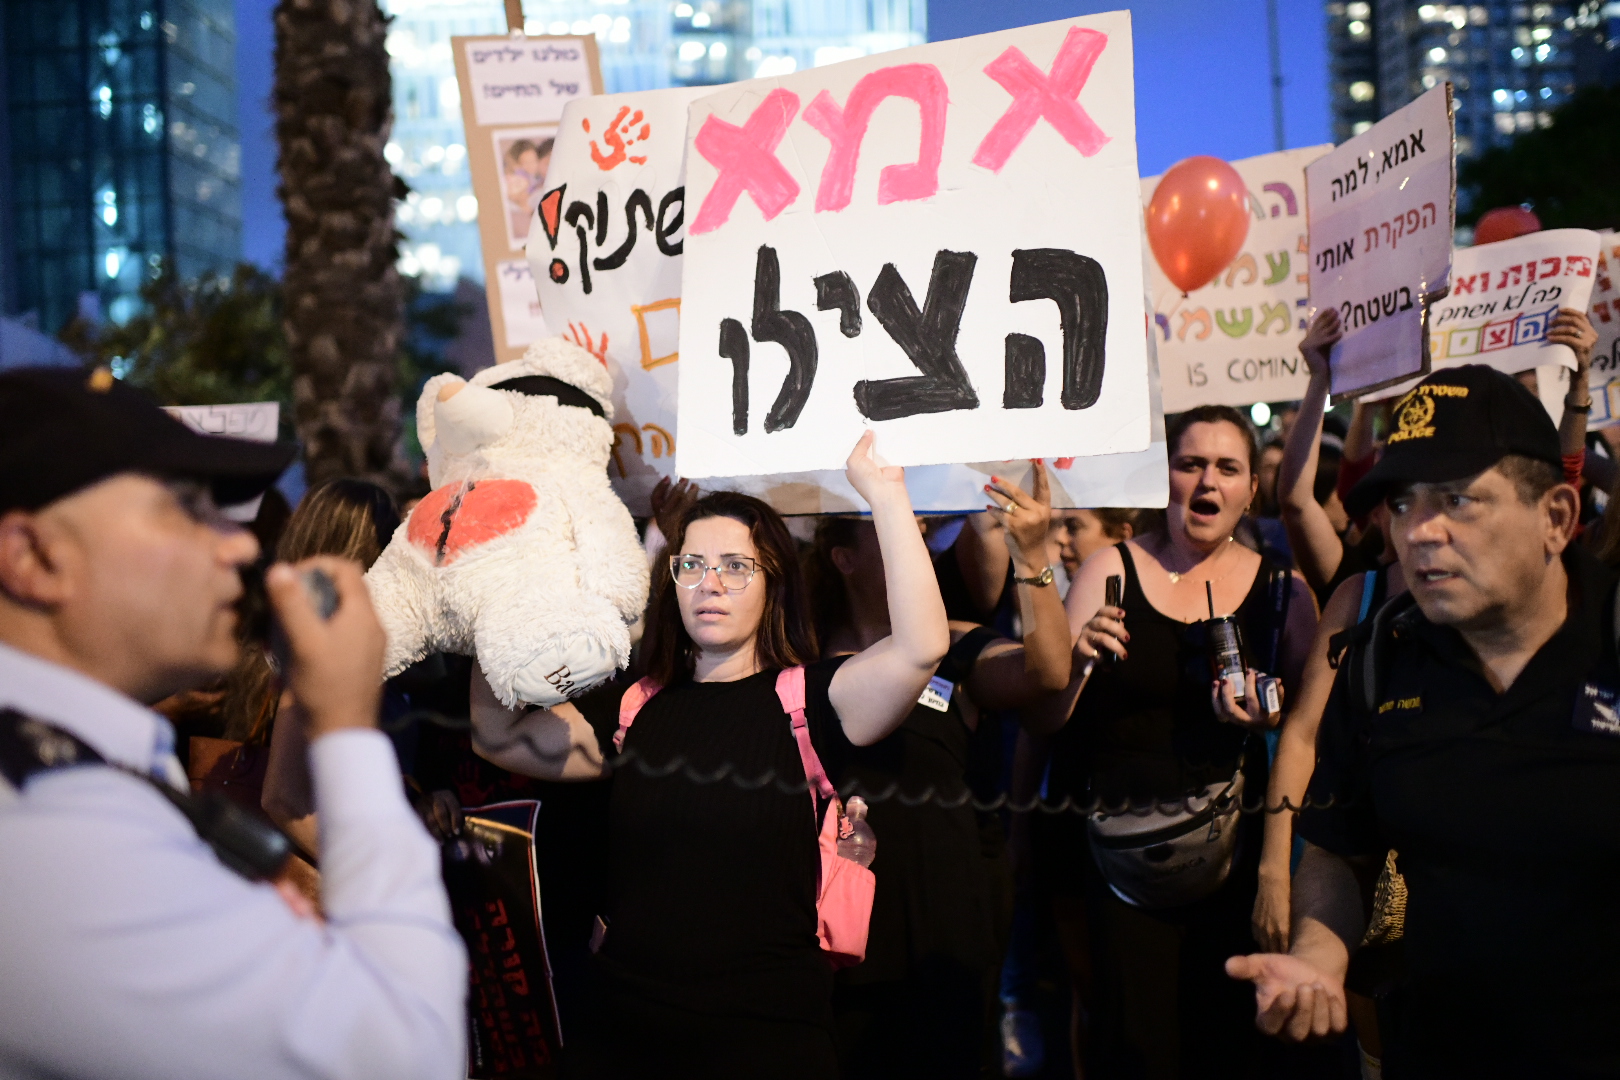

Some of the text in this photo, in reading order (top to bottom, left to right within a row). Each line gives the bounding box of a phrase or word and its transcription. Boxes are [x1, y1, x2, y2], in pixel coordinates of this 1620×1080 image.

[689, 25, 1113, 235] אמא
[1375, 128, 1426, 183] אמא,
[1331, 156, 1369, 202] למה
[1316, 202, 1436, 274] הפקרת אותי
[1497, 255, 1592, 290] מכות
[1340, 286, 1414, 333] בשטח?
[1437, 300, 1498, 327] משחק
[1503, 281, 1538, 312] לא
[719, 244, 1109, 436] הצילו
[1187, 362, 1208, 388] IS
